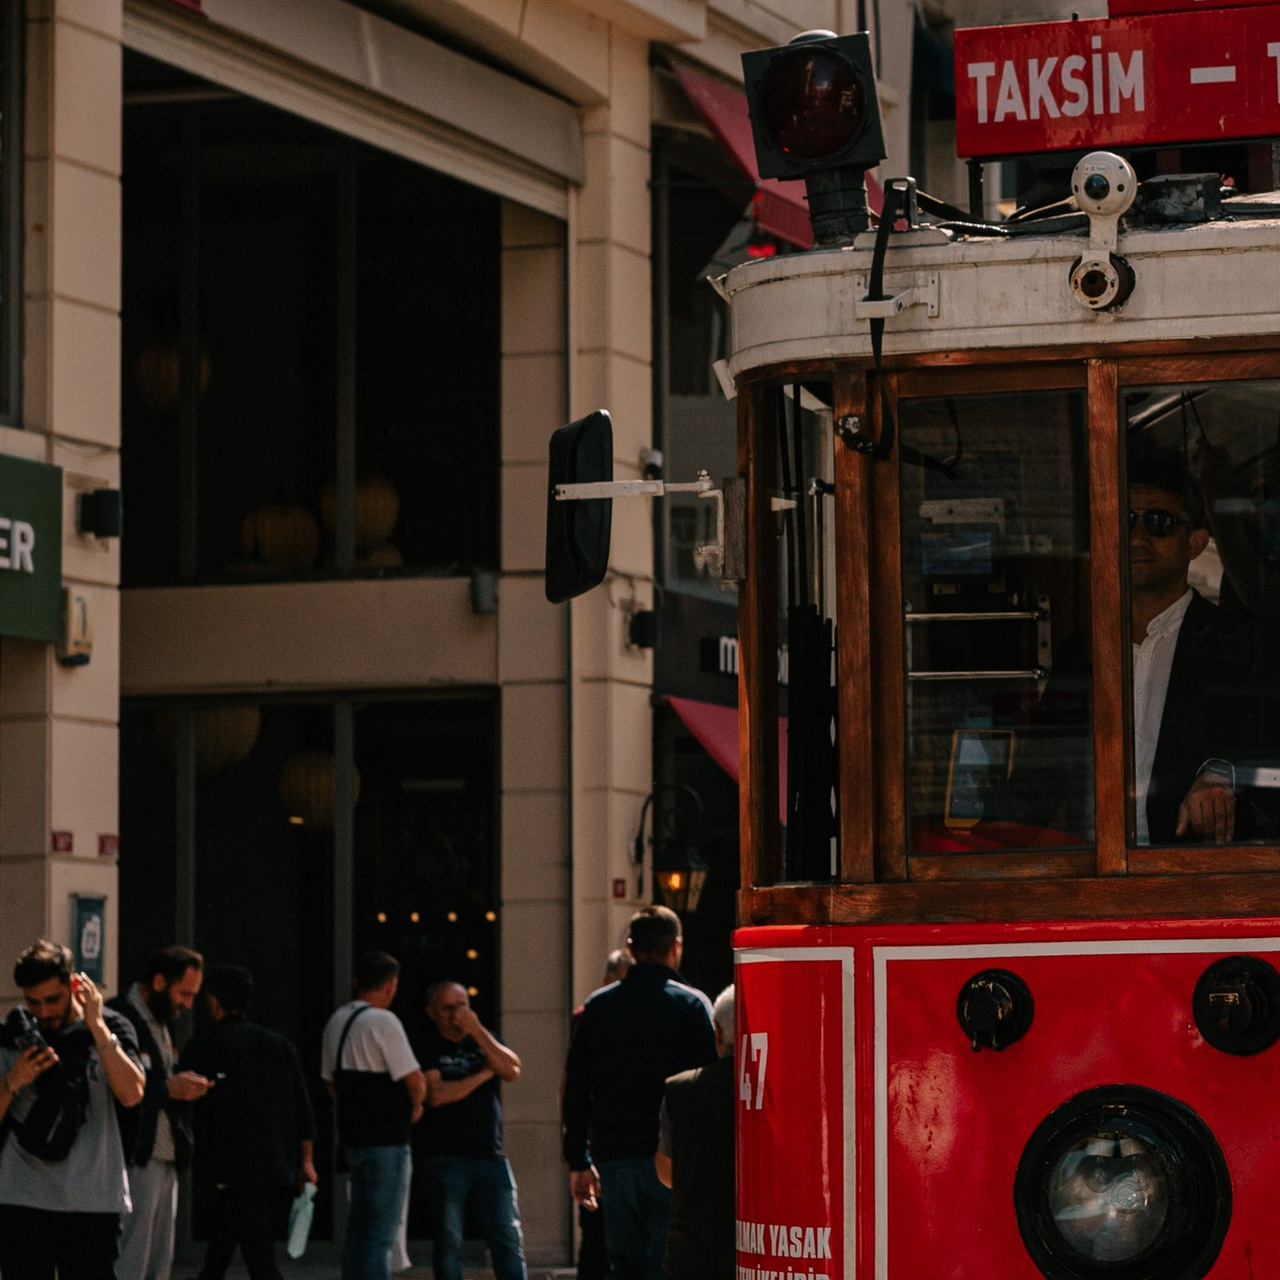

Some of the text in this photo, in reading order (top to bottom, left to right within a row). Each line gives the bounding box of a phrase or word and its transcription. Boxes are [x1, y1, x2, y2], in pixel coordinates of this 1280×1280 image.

[967, 35, 1145, 124] TAKSİM
[740, 1032, 768, 1111] 47
[769, 1224, 832, 1259] YASAK
